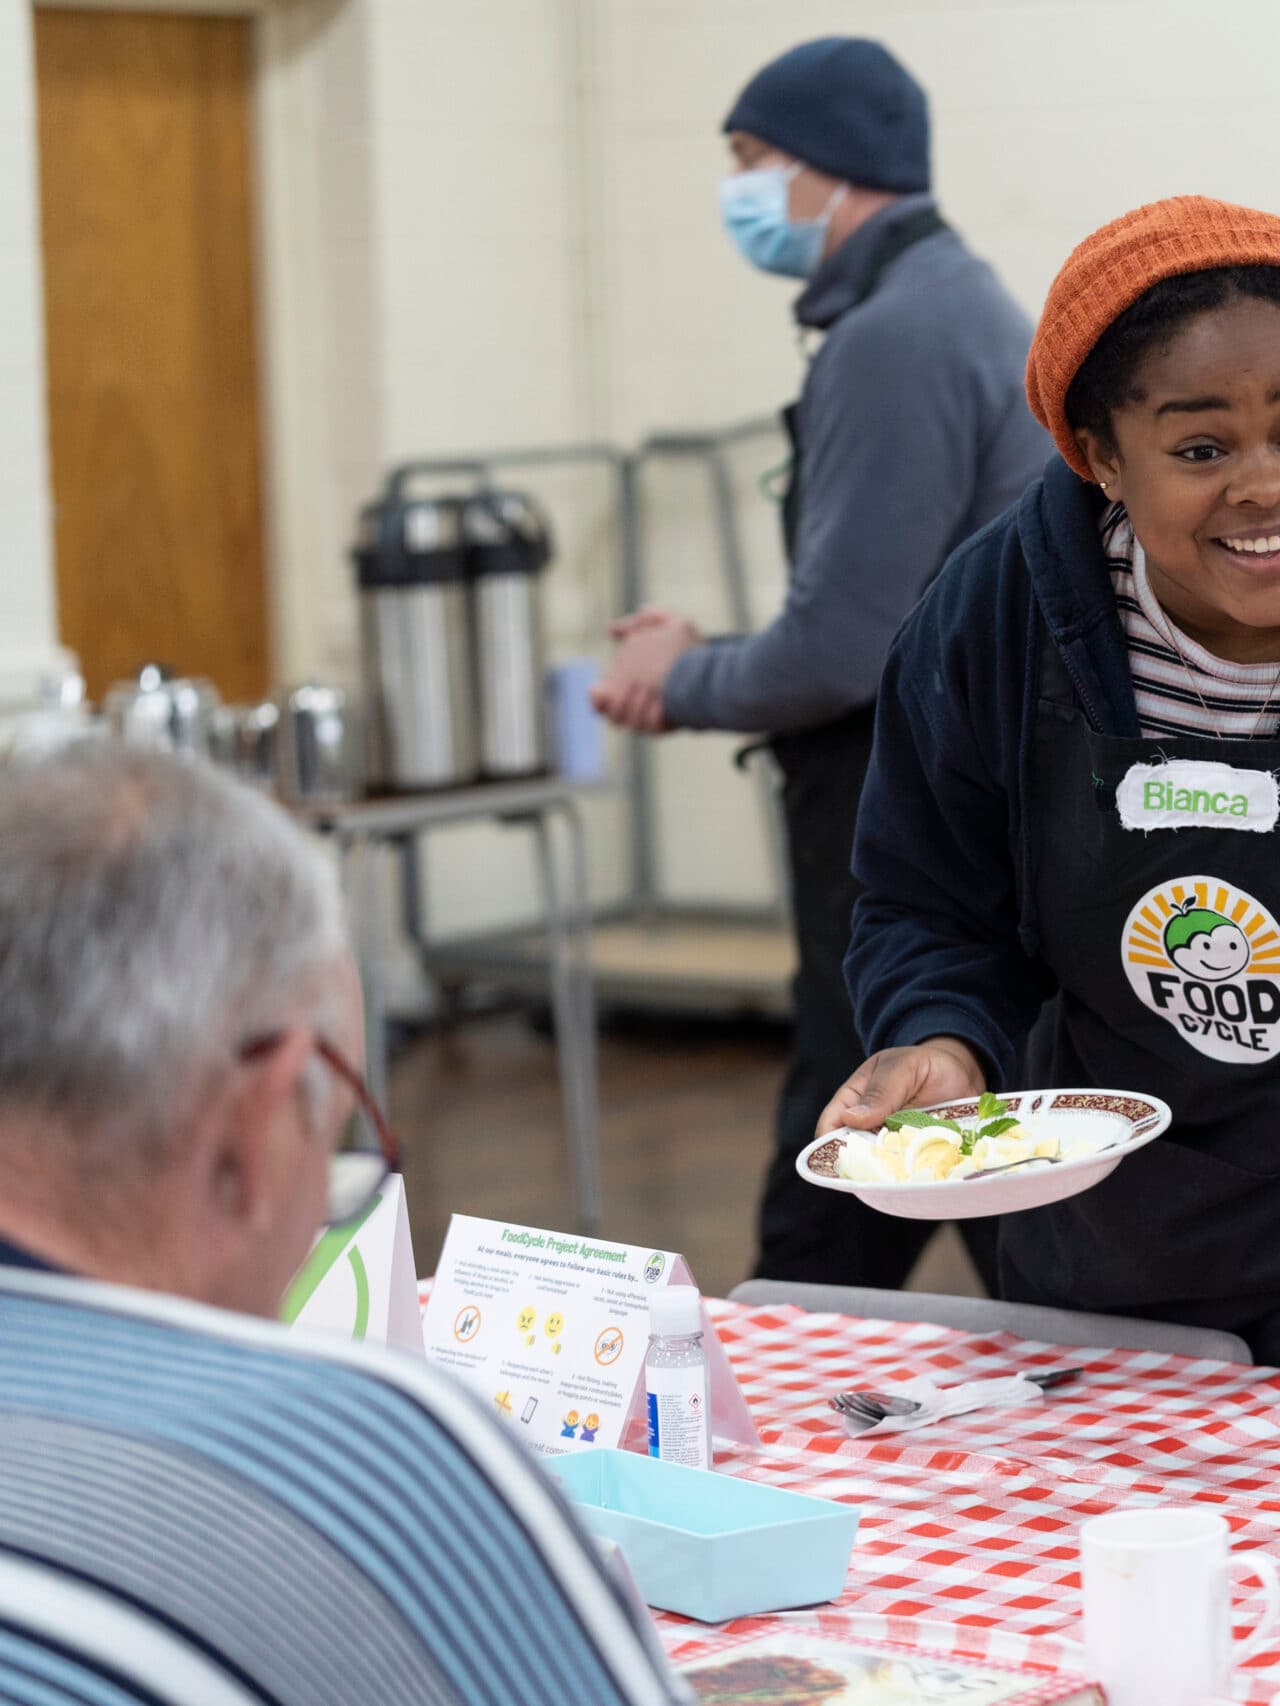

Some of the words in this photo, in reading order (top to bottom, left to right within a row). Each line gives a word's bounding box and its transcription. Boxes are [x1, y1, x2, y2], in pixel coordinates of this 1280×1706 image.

[1143, 780, 1249, 818] Bianca
[1177, 1012, 1270, 1052] CYCLE
[501, 1228, 546, 1249] FoodCycle
[546, 1236, 579, 1255] Project
[580, 1243, 627, 1263] Agreement
[513, 1253, 540, 1263] everyone
[567, 1261, 585, 1271] follow
